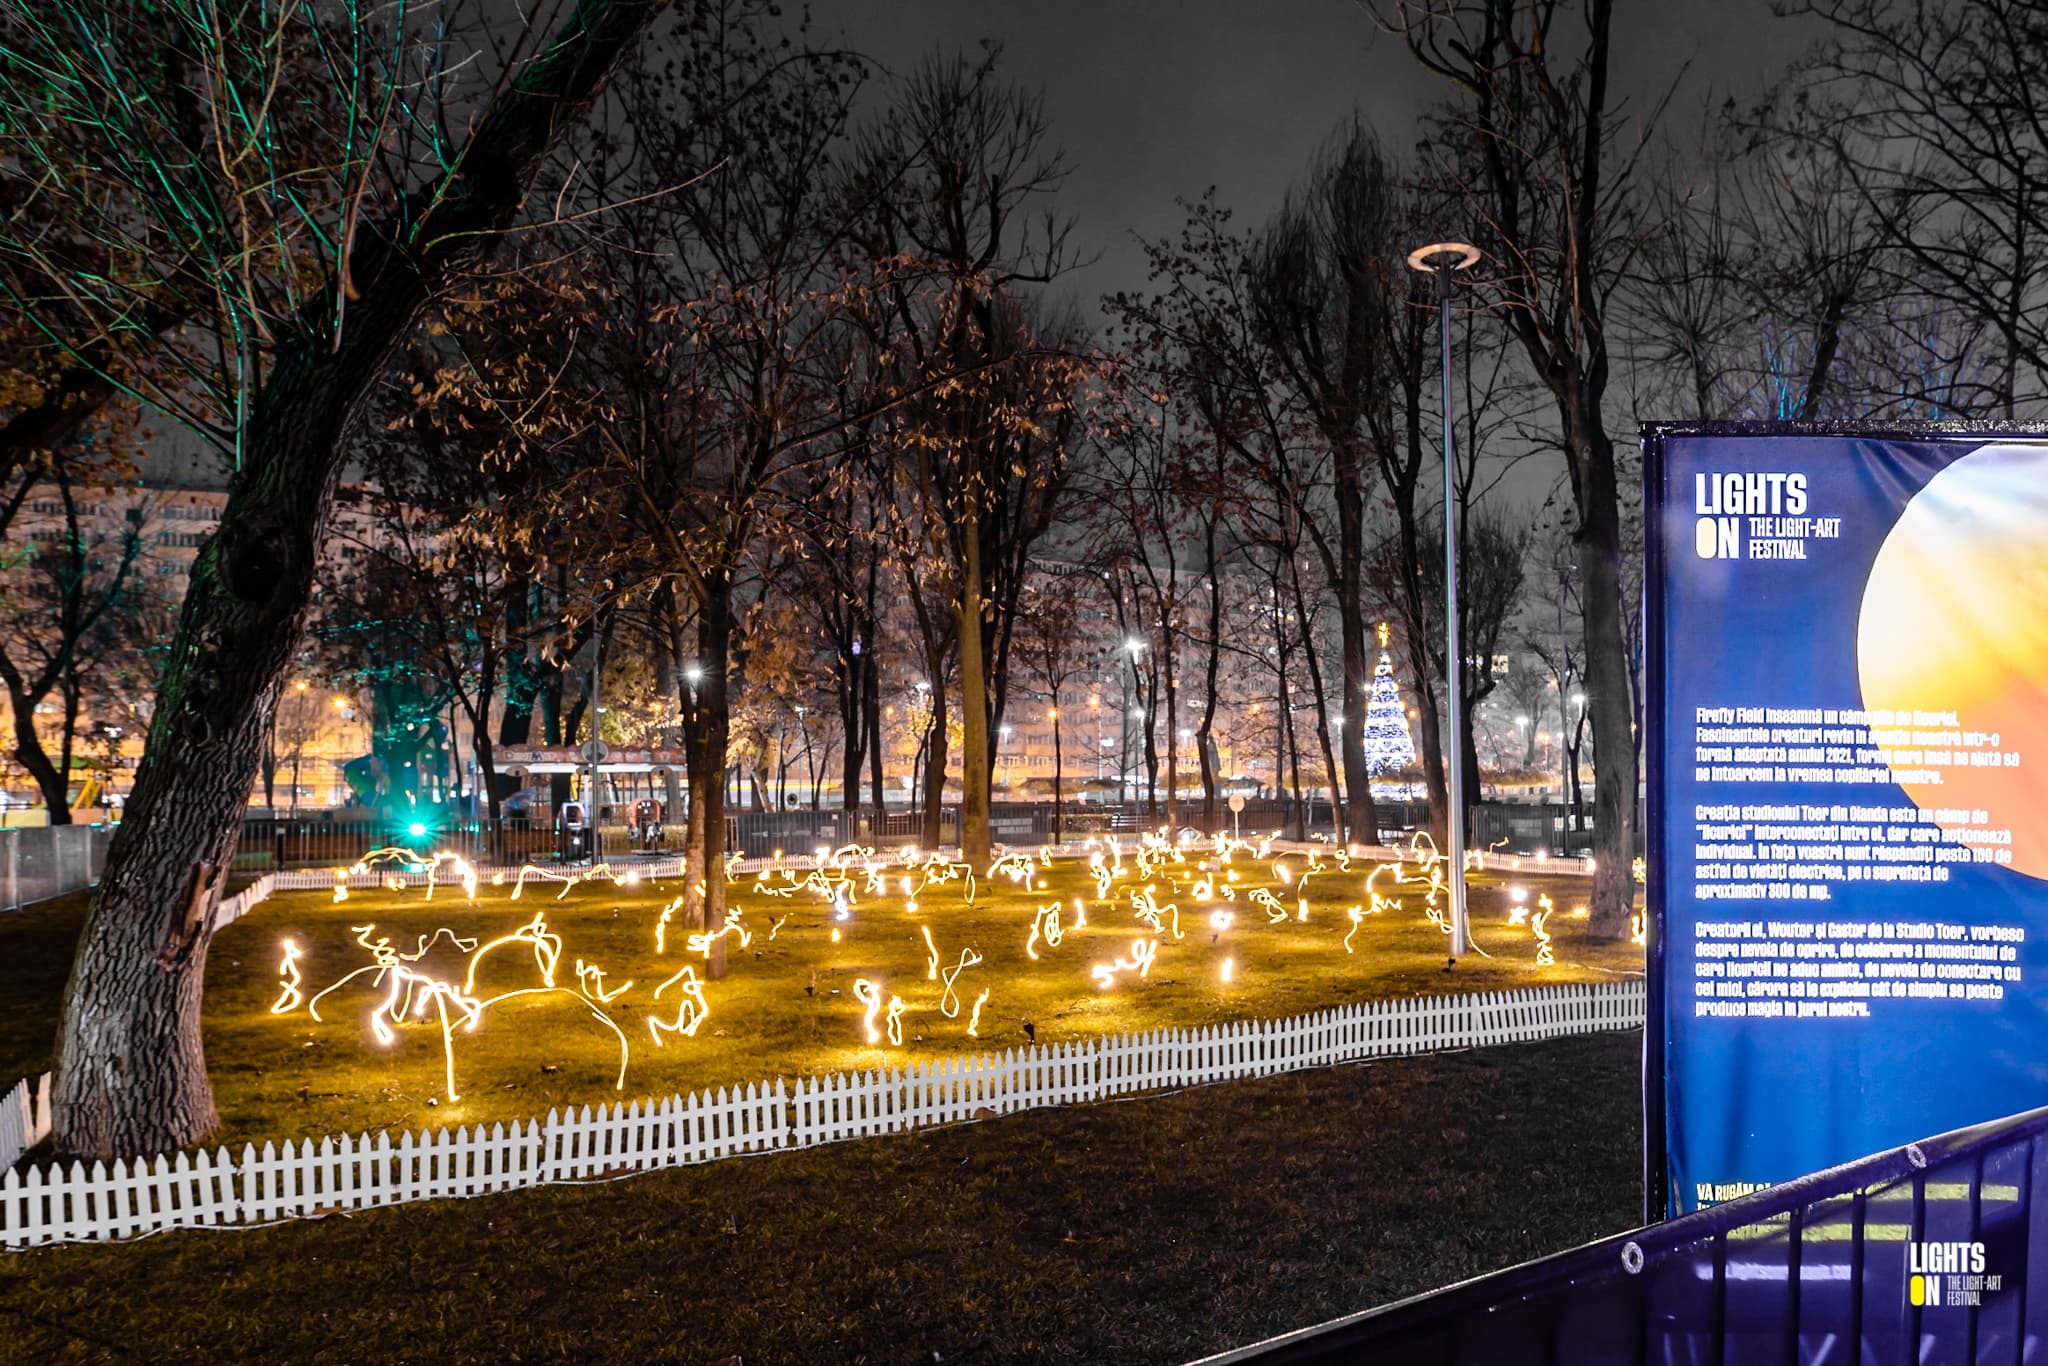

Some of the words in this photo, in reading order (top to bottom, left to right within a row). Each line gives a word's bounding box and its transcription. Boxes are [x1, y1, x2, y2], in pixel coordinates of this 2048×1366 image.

[1695, 473, 1808, 515] LIGHTS
[1696, 517, 1740, 560] ON
[1749, 518, 1774, 537] THE
[1775, 518, 1841, 538] LIGHT-ART
[1749, 540, 1807, 560] FESTIVAL
